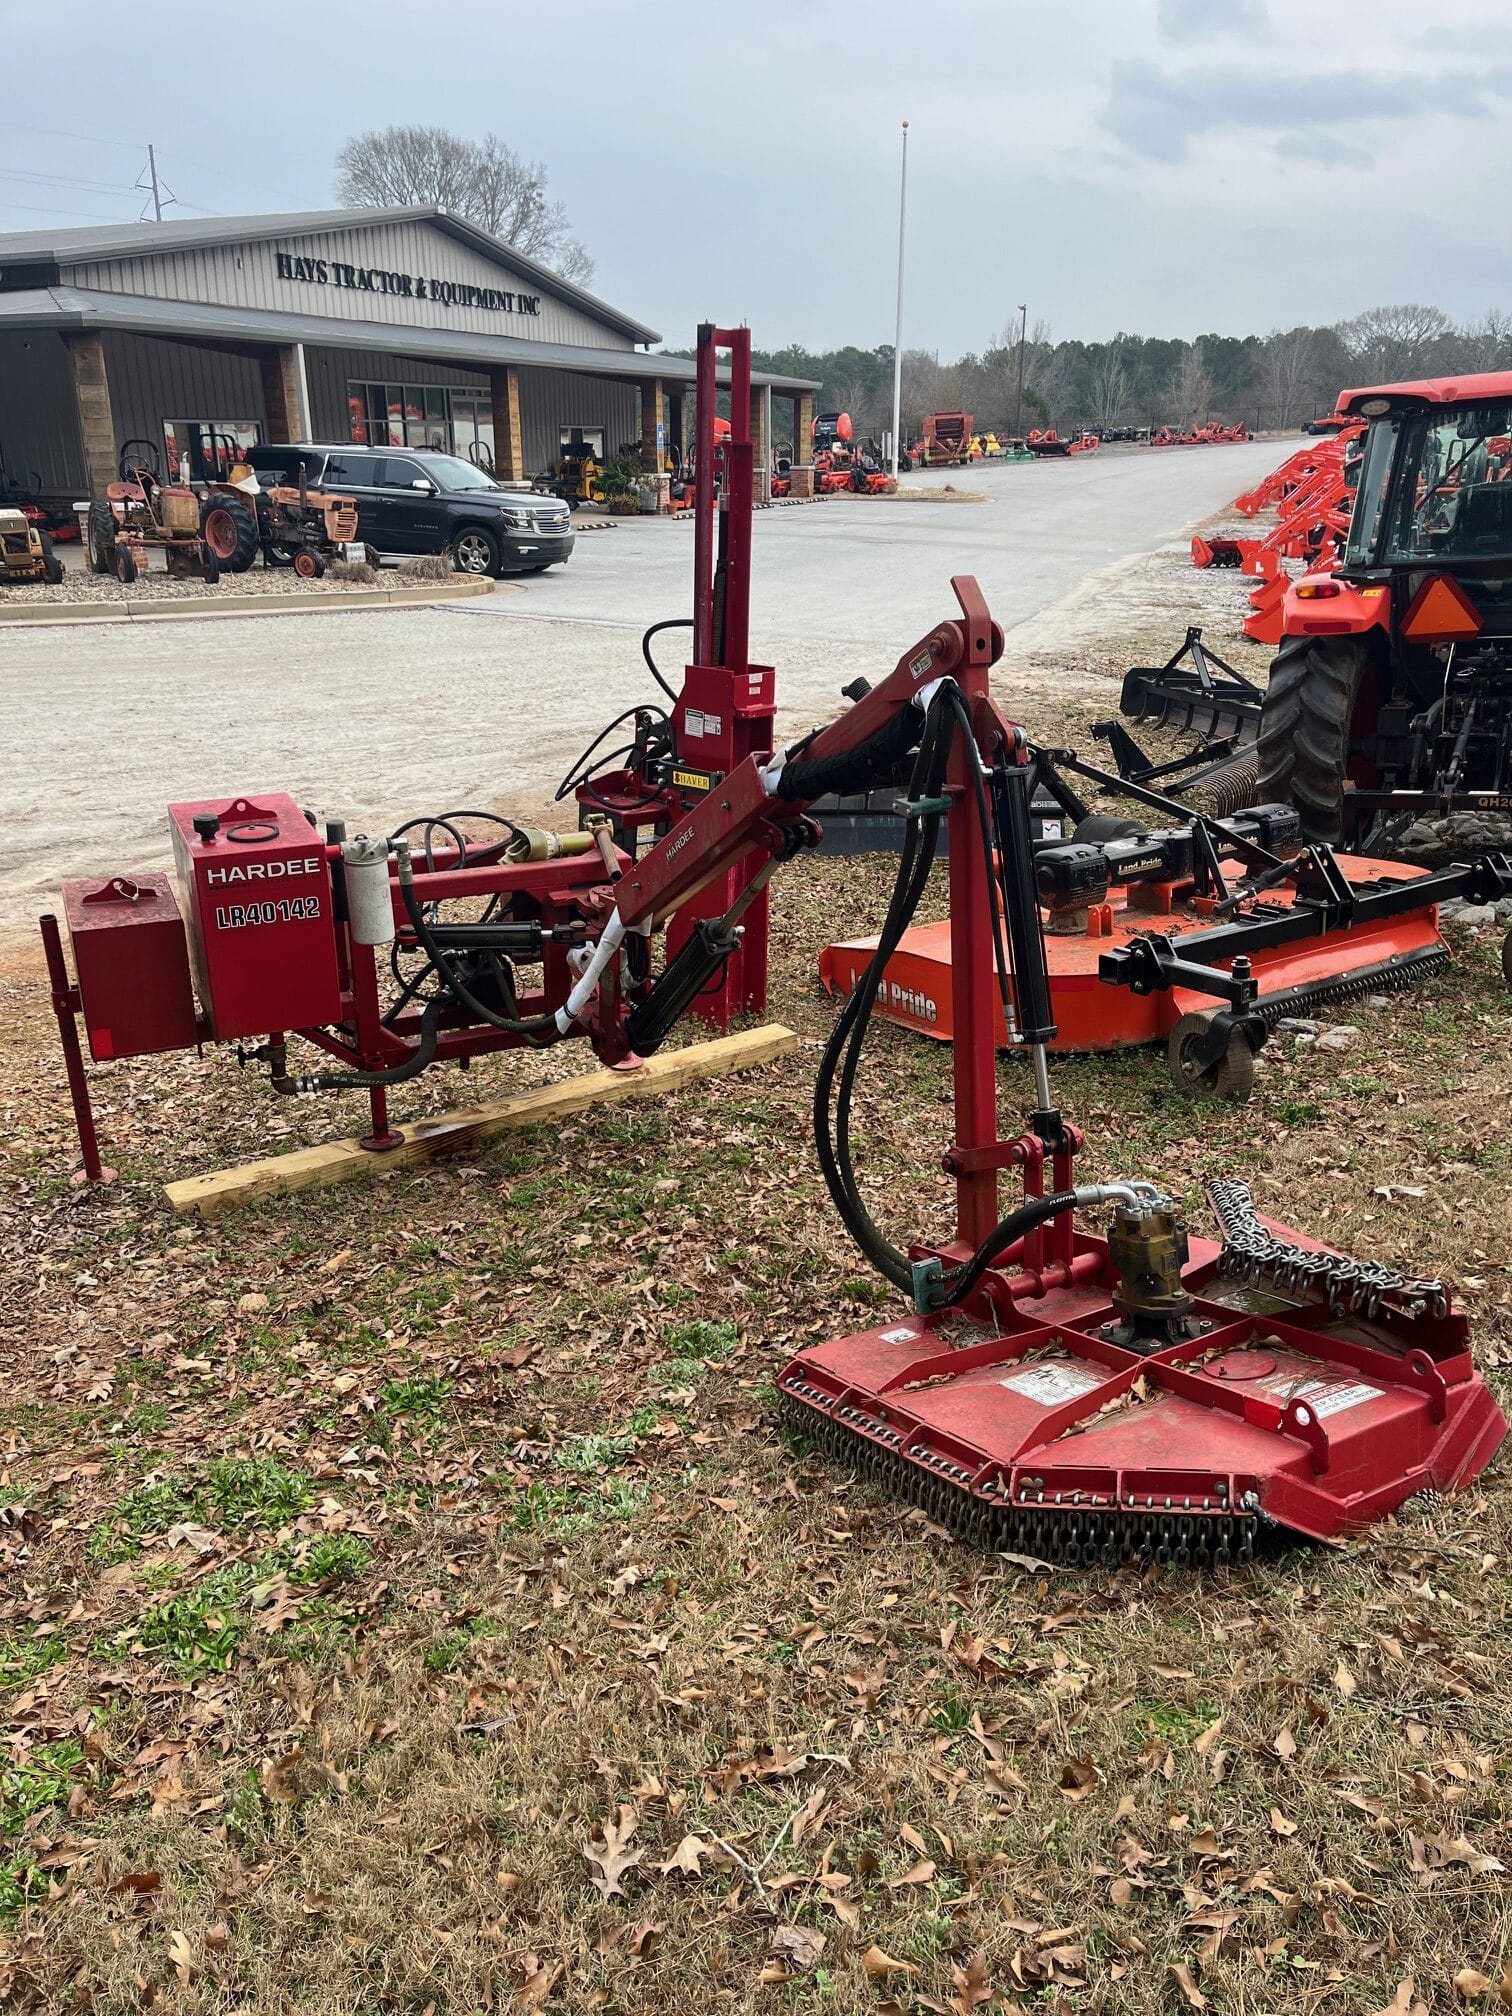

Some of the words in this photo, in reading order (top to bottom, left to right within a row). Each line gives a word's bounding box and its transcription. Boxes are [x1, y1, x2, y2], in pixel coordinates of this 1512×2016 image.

[277, 252, 328, 283] HAYS
[332, 262, 413, 297] TRACTOR
[416, 276, 428, 299] &
[431, 278, 516, 312] EQUIPMENT
[518, 293, 542, 316] INC
[674, 771, 709, 789] SHAVER
[665, 825, 695, 862] HARDEE
[207, 857, 321, 884] HARDEE
[1117, 861, 1139, 873] Land
[1141, 857, 1163, 868] Pride
[216, 896, 320, 930] LR40142
[850, 967, 888, 1006] Ld
[891, 981, 938, 1023] Pride
